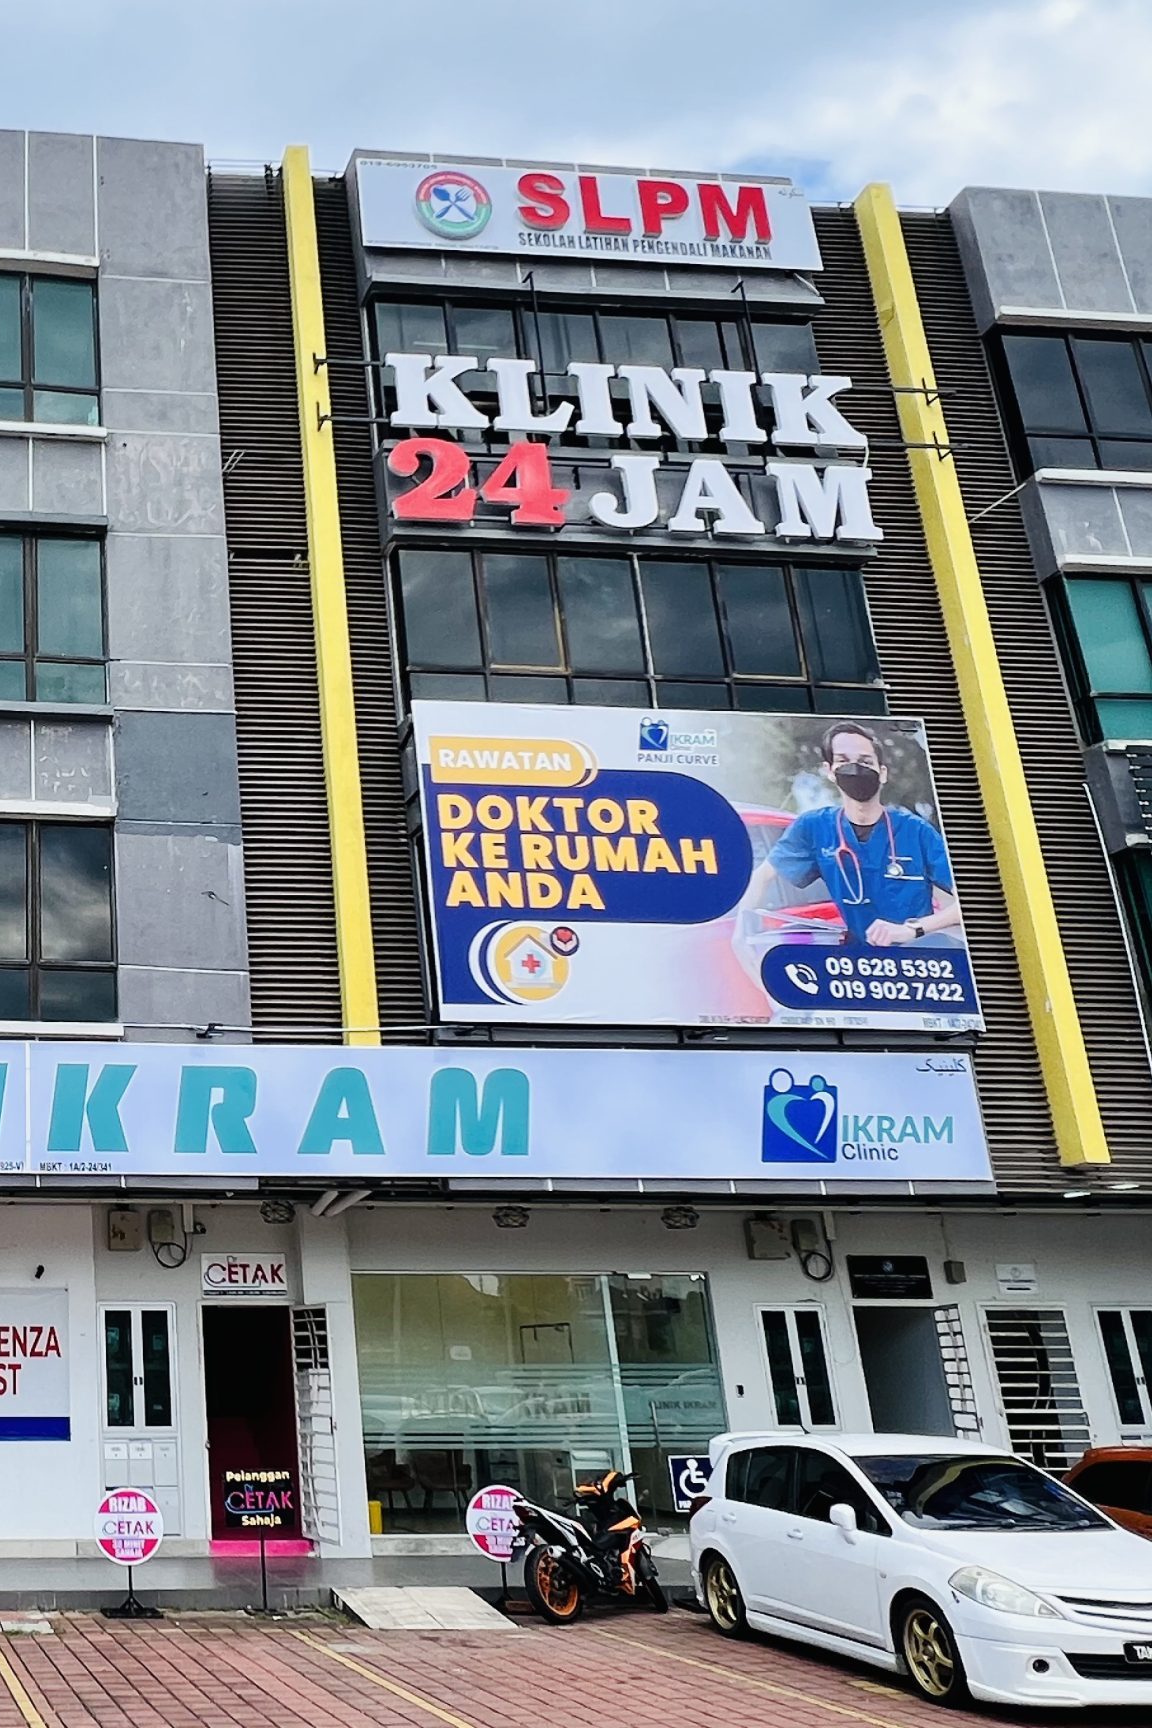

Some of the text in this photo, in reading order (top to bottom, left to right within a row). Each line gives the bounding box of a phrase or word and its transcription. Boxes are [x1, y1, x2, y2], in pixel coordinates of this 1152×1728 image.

[517, 172, 773, 245] SLPM
[518, 232, 576, 249] SEKOLAH
[578, 236, 629, 252] LATIHAN
[633, 239, 708, 257] PENGENDALI
[710, 243, 772, 260] MAKANAN
[385, 352, 868, 448] KLINIK
[387, 437, 884, 541] 24 JAM
[669, 733, 716, 746] IKRAM
[438, 747, 573, 773] RAWATAN
[637, 753, 719, 766] PANJI CURVE
[436, 793, 660, 836] DOKTOR
[441, 832, 719, 875] KE RUMAH
[445, 871, 606, 910] ANDA
[825, 957, 955, 979] 09 628 5392
[829, 980, 965, 1002] 019 902 7422
[842, 1115, 953, 1144] IKRAM
[842, 1143, 899, 1160] Clinic
[40, 1162, 62, 1172] MBKT
[204, 1262, 285, 1286] CETAK
[225, 1470, 290, 1483] Pelanggan
[108, 1495, 147, 1513] RIZAB
[226, 1491, 294, 1511] CETAK
[103, 1520, 154, 1536] CETAK
[241, 1513, 282, 1528] Sahaja
